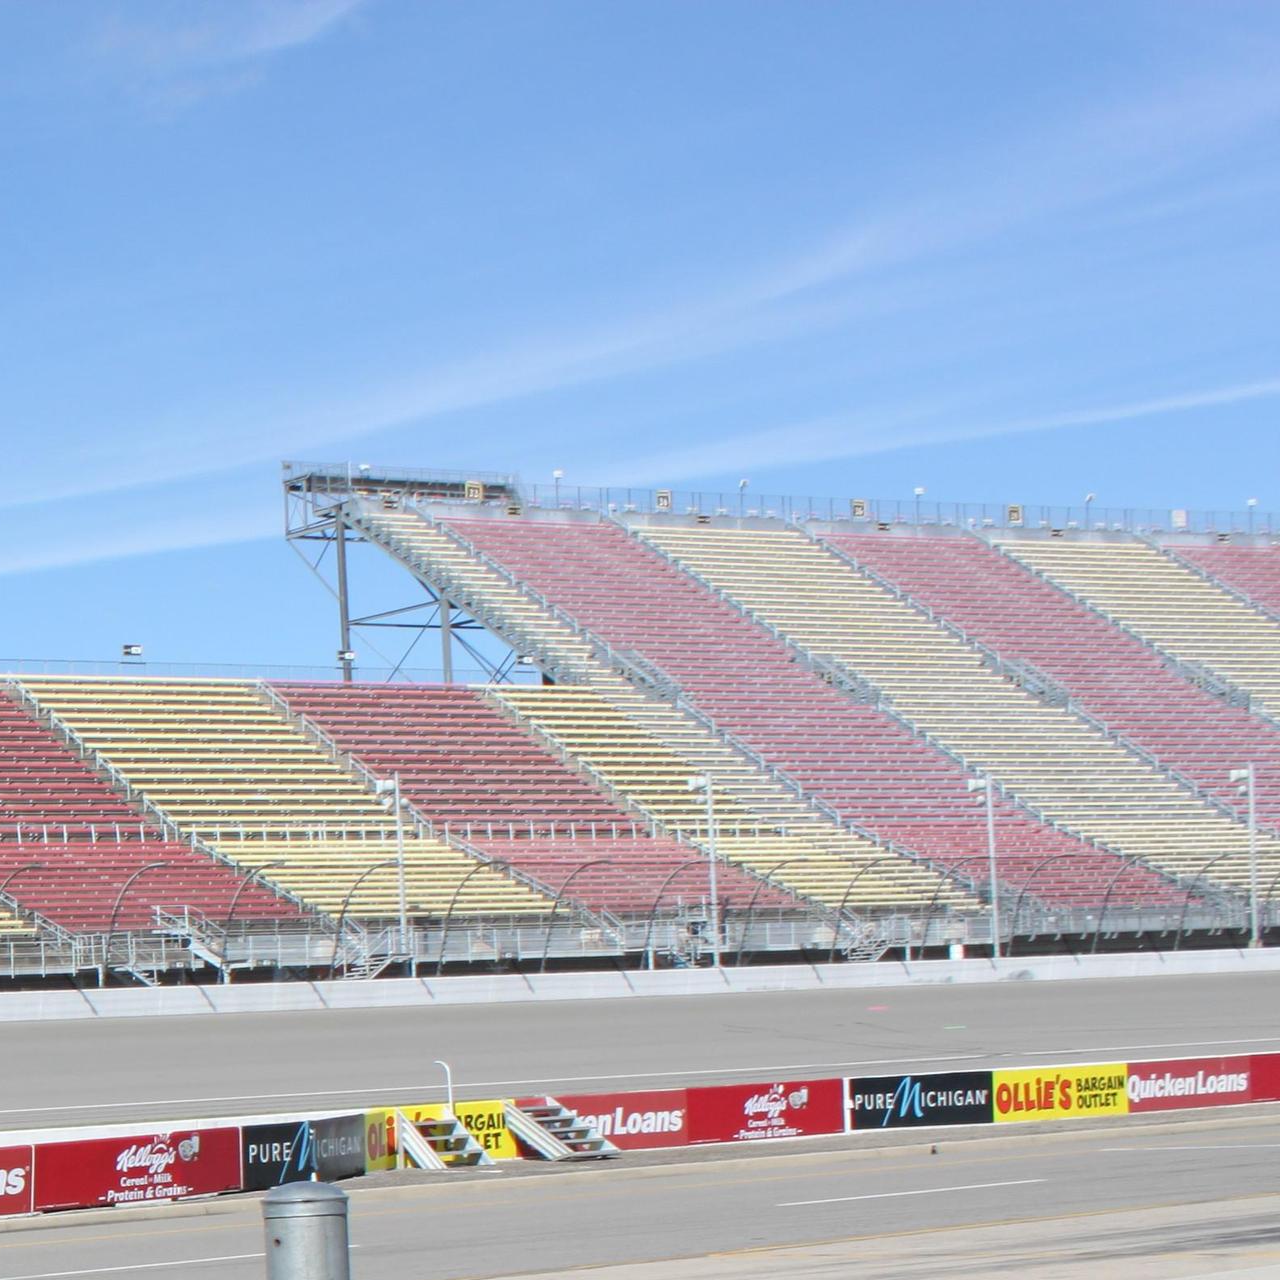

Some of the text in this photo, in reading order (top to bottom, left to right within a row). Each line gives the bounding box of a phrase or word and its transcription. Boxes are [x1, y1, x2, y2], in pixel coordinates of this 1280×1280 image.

[1076, 1075, 1125, 1092] BARGAIN
[1127, 1070, 1249, 1103] Quicken Loans
[854, 1075, 987, 1127] PURE MICHIGAN
[1076, 1092, 1118, 1109] OUTLET
[612, 1105, 684, 1136] Loans
[115, 1143, 177, 1174] Kellogg's
[248, 1141, 293, 1165] PURE
